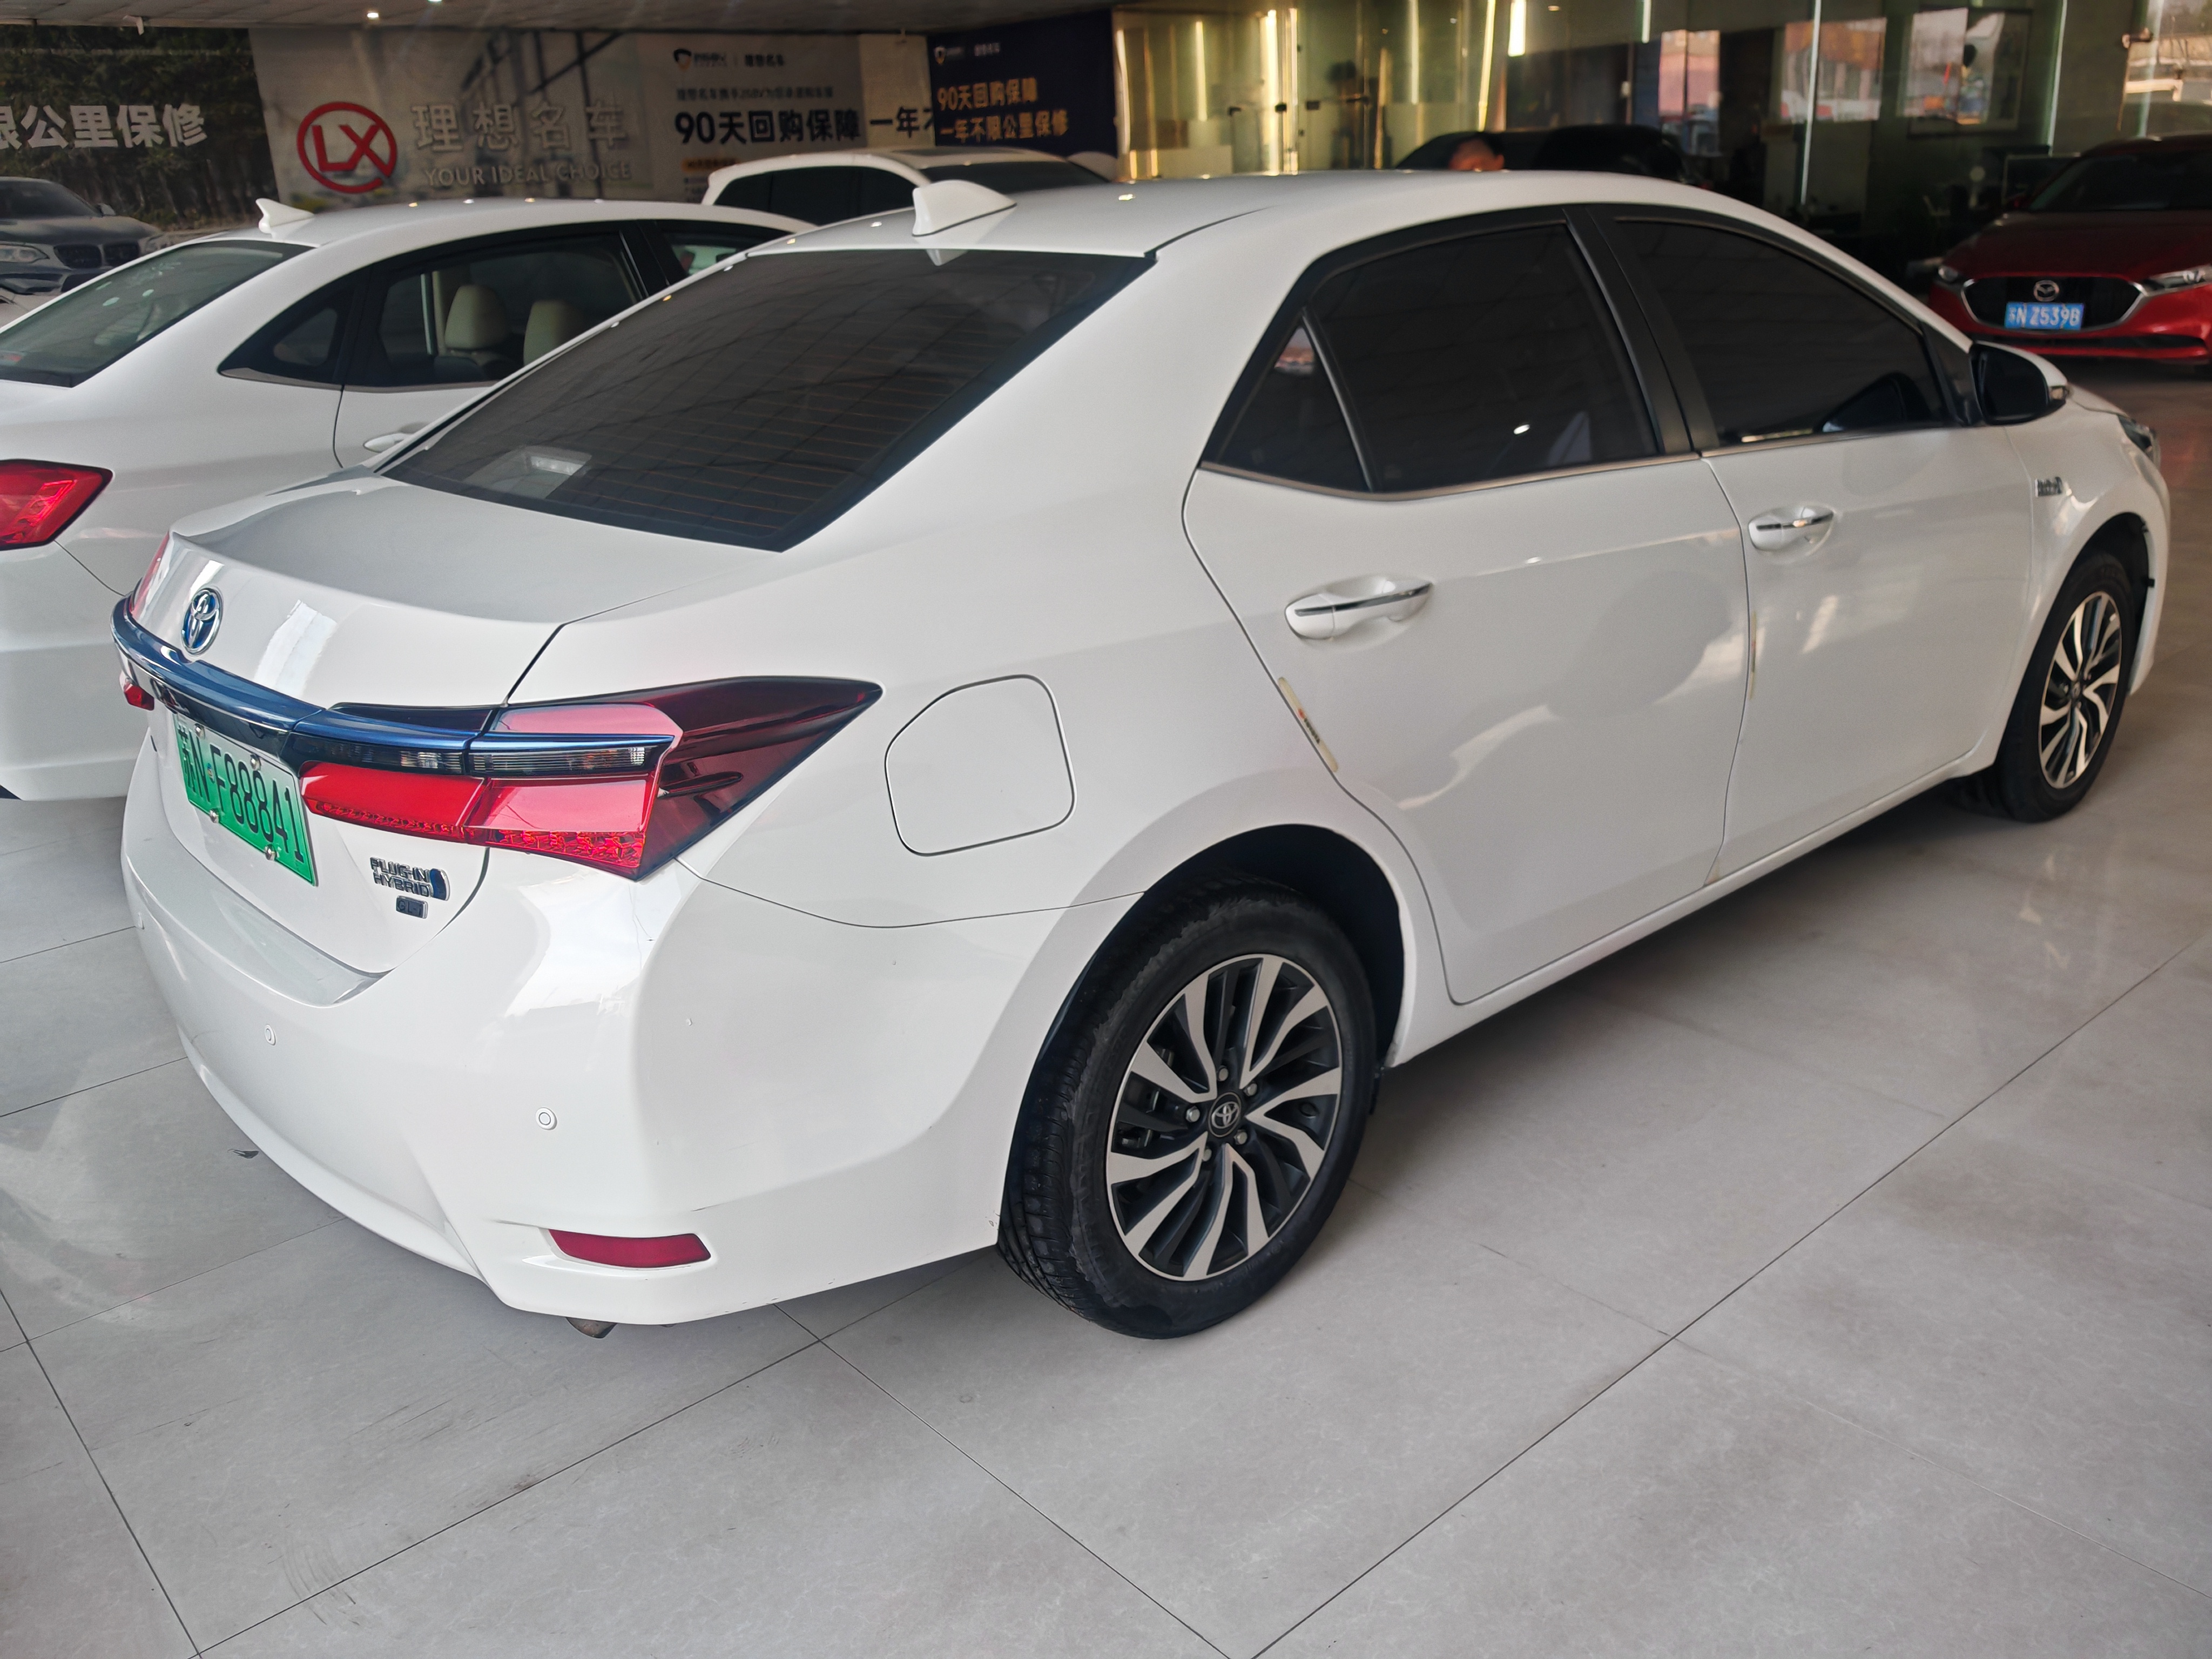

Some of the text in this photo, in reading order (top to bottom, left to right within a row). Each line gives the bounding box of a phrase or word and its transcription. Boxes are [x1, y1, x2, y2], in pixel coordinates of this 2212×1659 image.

[411, 101, 628, 152] 理想名车
[675, 110, 860, 145] 90天回购保障
[310, 123, 394, 178] LX
[425, 161, 632, 187] YOUR IDEAL CHOICE
[370, 857, 430, 882] PLUG-IN
[373, 872, 434, 897] HYBRID
